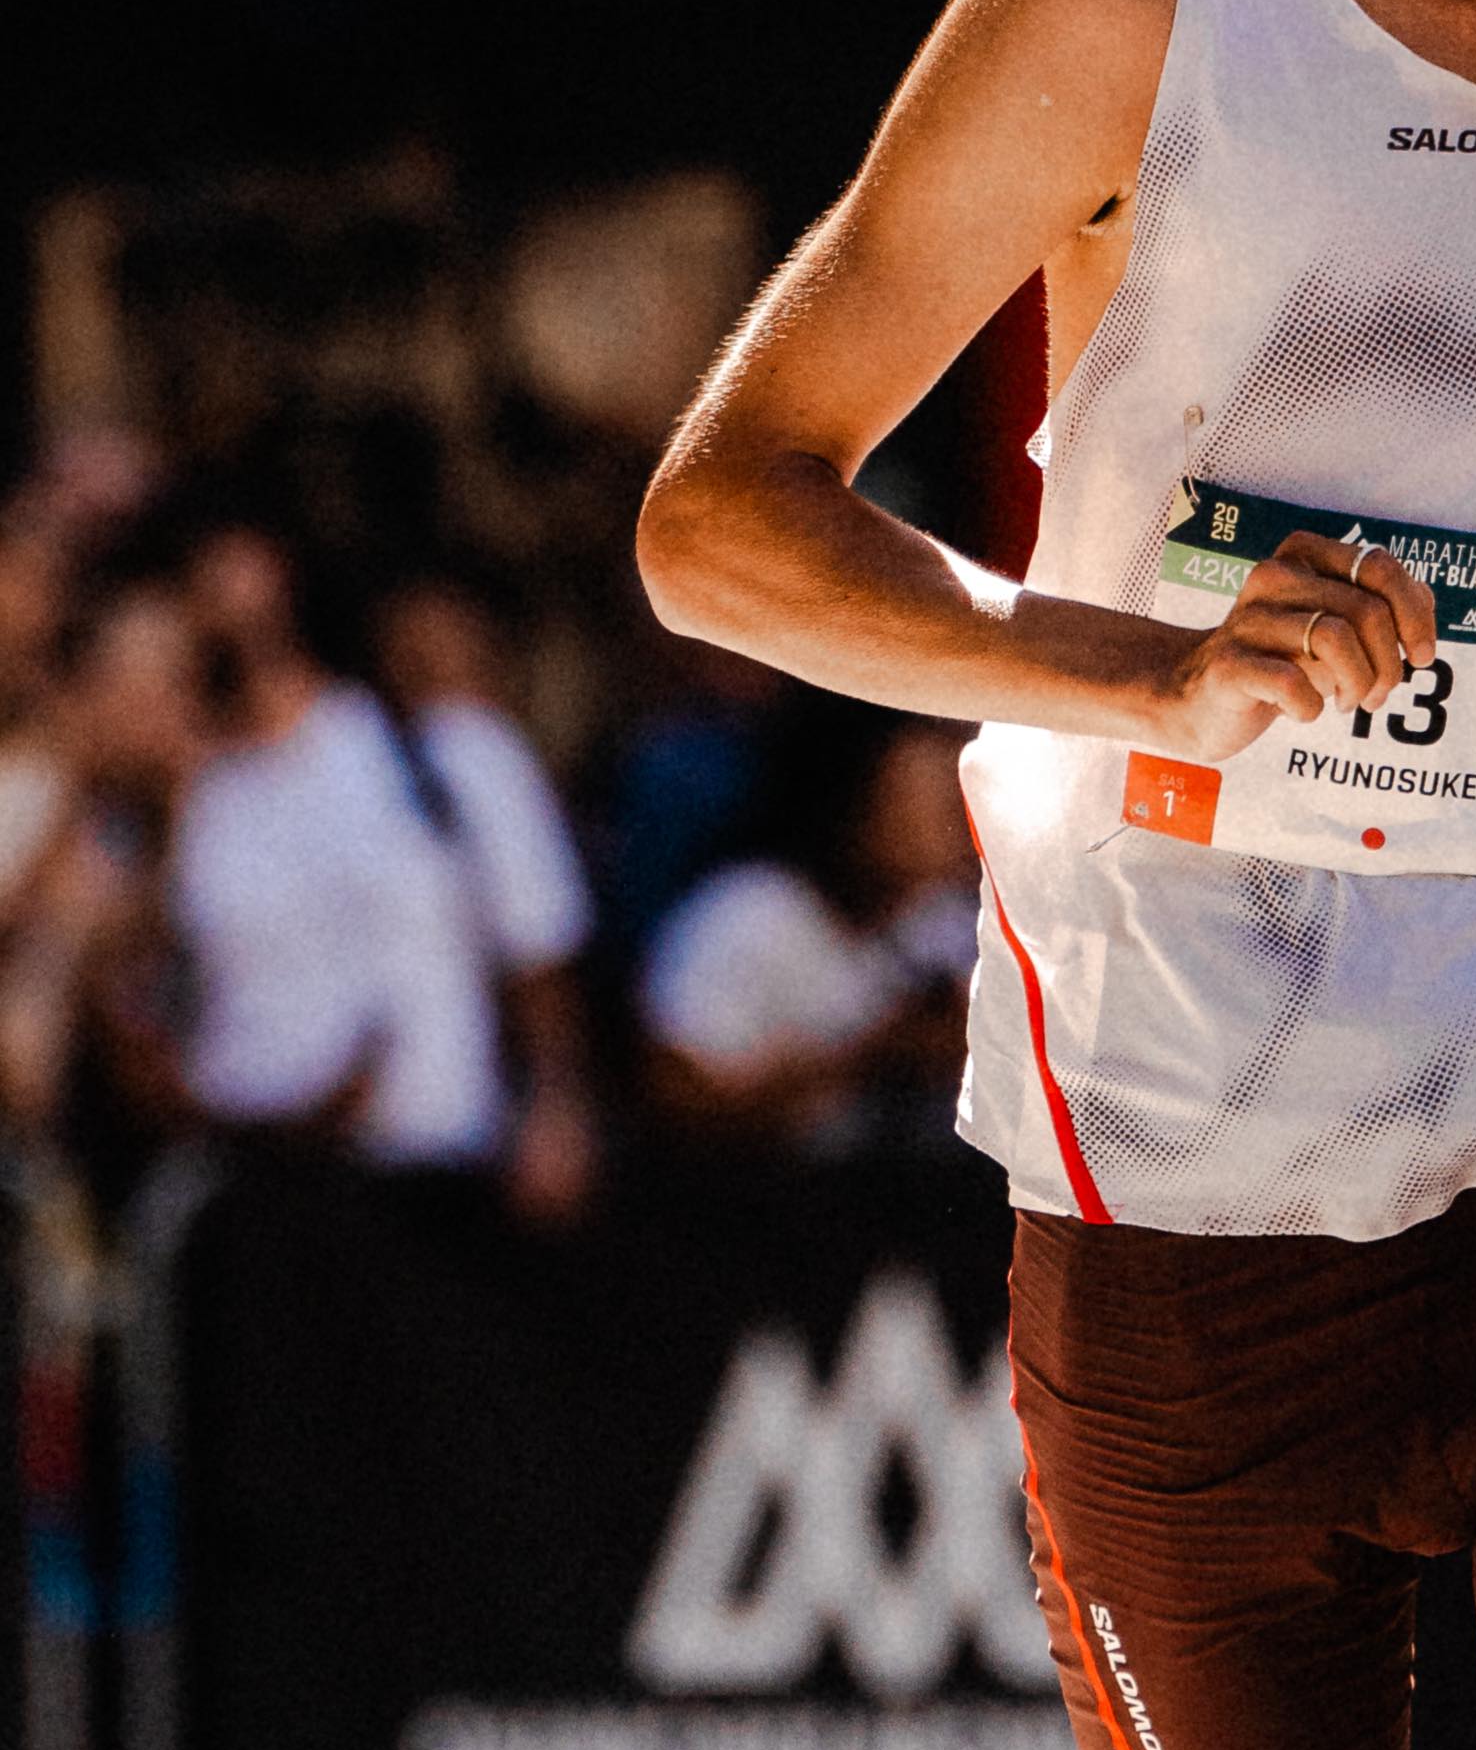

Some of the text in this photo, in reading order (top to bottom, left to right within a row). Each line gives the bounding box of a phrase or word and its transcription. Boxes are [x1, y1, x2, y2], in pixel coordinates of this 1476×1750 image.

[1213, 502, 1239, 525] 20
[1210, 521, 1236, 542] 25
[1182, 553, 1253, 591] 42K
[1158, 773, 1185, 791] SAS
